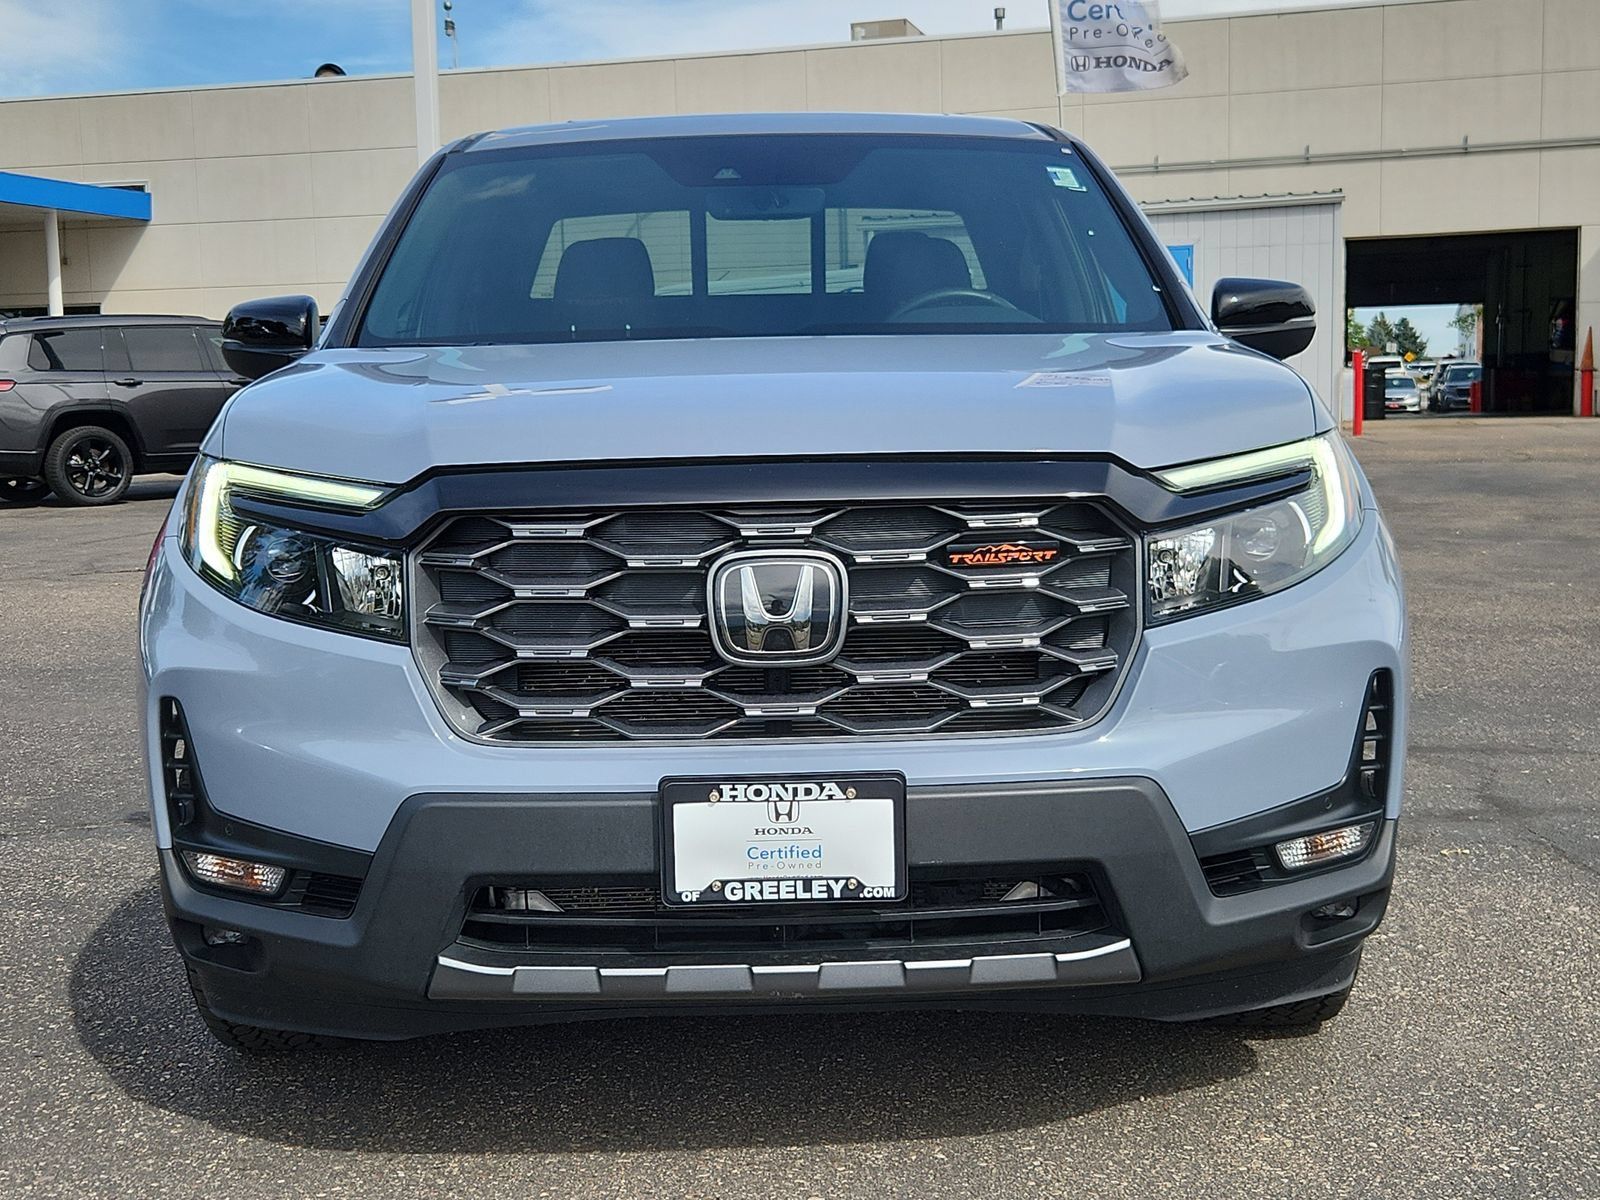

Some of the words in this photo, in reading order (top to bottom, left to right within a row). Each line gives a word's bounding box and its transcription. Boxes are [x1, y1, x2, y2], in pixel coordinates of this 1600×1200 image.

[1094, 55, 1174, 72] HONDA
[949, 551, 1057, 565] TRAILSPORT
[719, 783, 846, 802] HONDA
[754, 827, 814, 836] HONDA
[747, 845, 822, 860] Certified
[748, 861, 822, 870] Pre-Owned
[681, 890, 700, 902] OF
[724, 879, 846, 901] GREELEY
[859, 886, 895, 898] .COM
